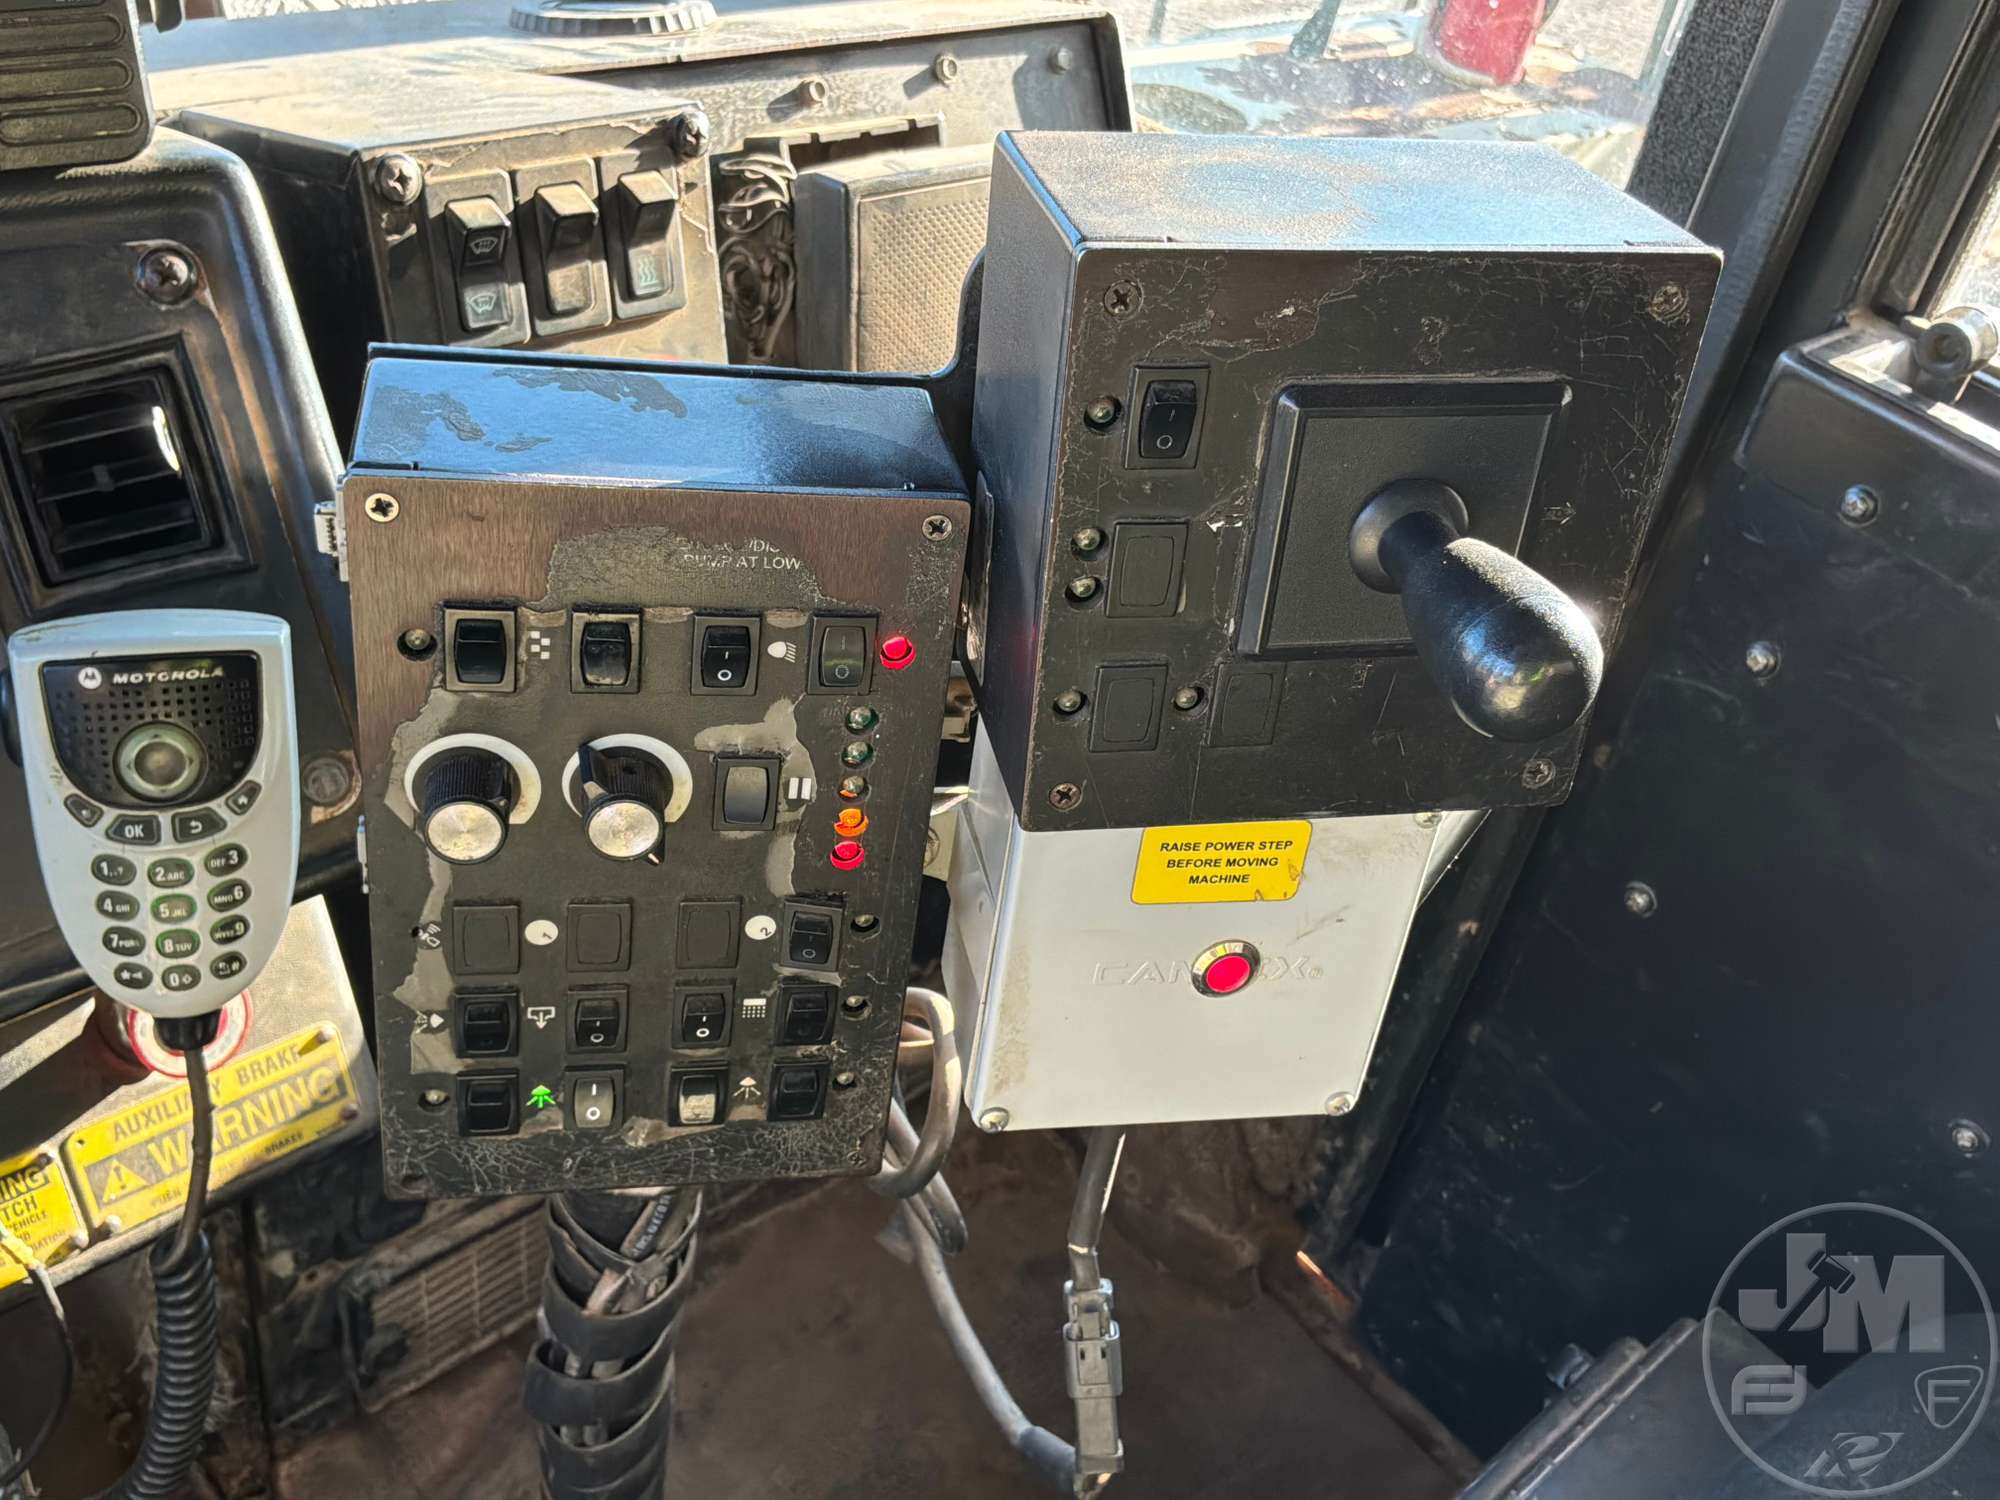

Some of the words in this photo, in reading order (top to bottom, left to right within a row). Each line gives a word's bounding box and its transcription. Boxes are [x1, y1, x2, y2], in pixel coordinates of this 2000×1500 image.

[735, 555, 758, 568] AT
[763, 556, 801, 569] LOW
[113, 667, 224, 684] MOTOROLA
[124, 824, 144, 838] OK
[1160, 842, 1202, 853] RAISE
[1204, 841, 1255, 852] POWER
[1257, 840, 1294, 851] STEP
[228, 850, 239, 865] 3
[1166, 858, 1222, 869] BEFORE
[1225, 857, 1279, 868] MOVING
[155, 866, 165, 881] 2
[1188, 874, 1250, 885] MACHINE
[233, 885, 244, 901] 6
[103, 898, 113, 912] 4
[159, 903, 170, 917] 5
[234, 922, 245, 935] 9
[110, 934, 119, 949] 7
[163, 938, 174, 953] 8
[147, 1066, 338, 1176] WRNING
